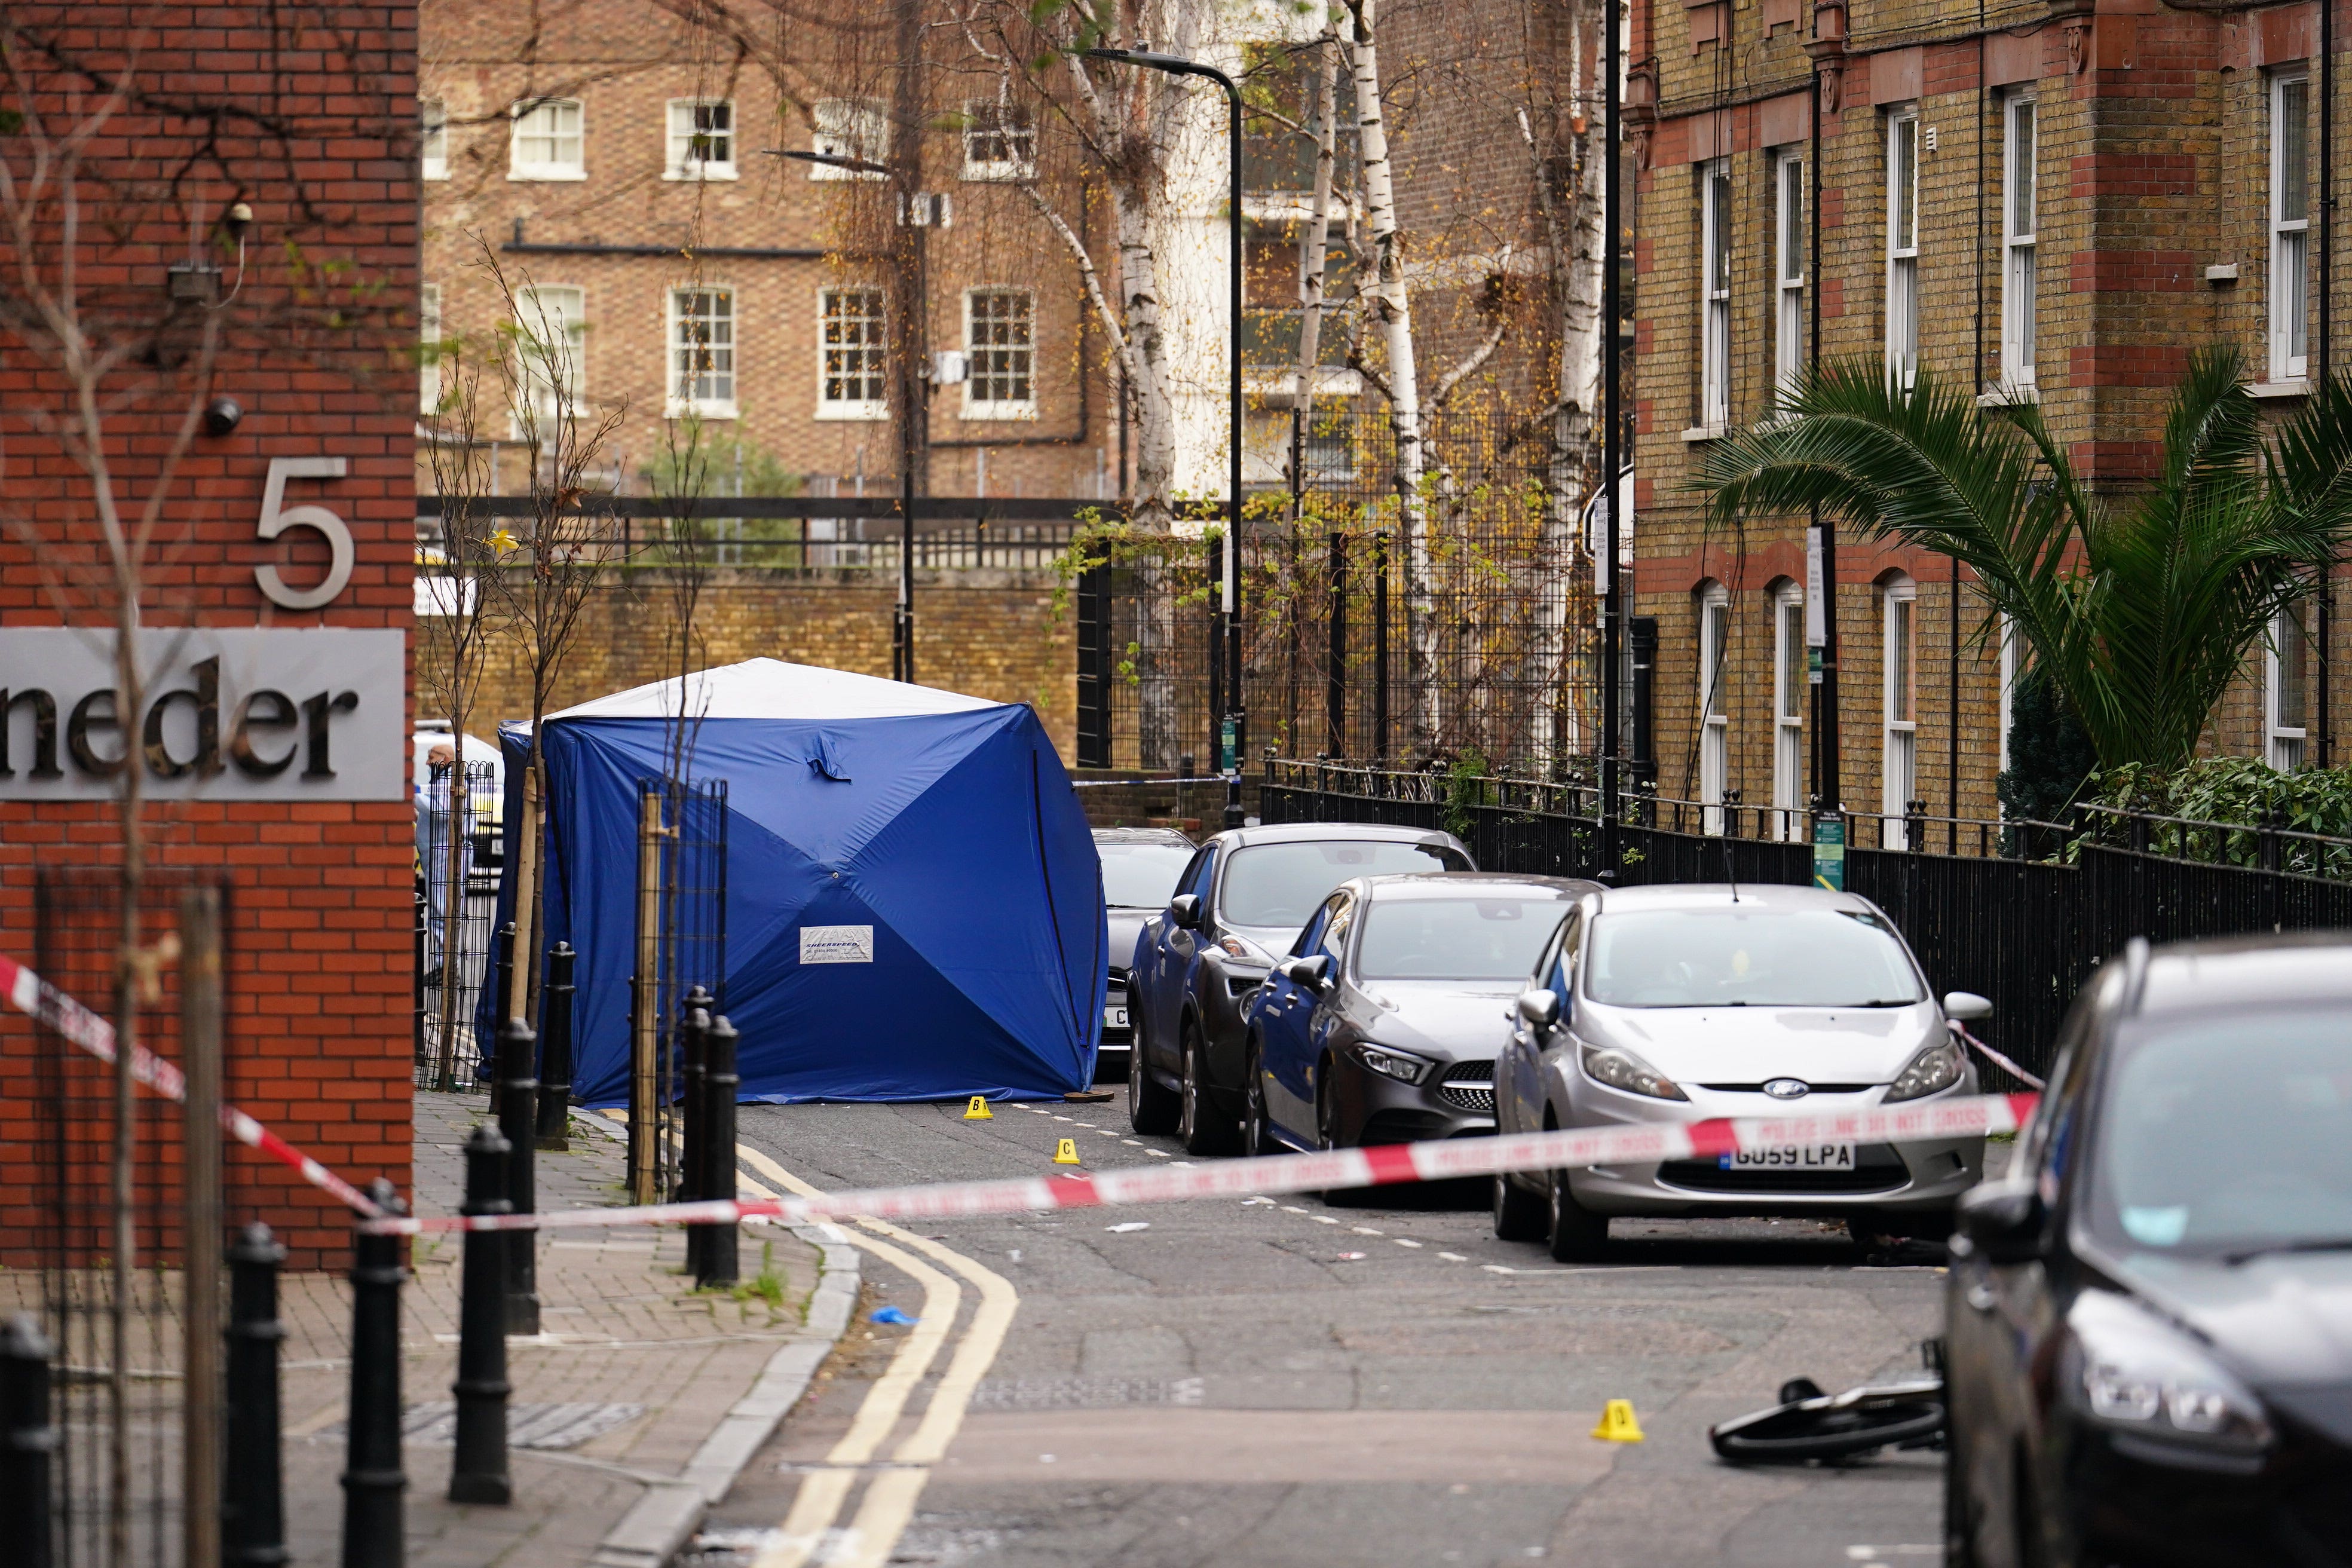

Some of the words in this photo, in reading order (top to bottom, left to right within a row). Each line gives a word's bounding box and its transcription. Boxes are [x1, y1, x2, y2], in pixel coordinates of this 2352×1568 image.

[254, 457, 354, 610] 5
[973, 1100, 980, 1110] B
[1063, 1142, 1070, 1154] C
[1805, 1144, 1849, 1165] LPA
